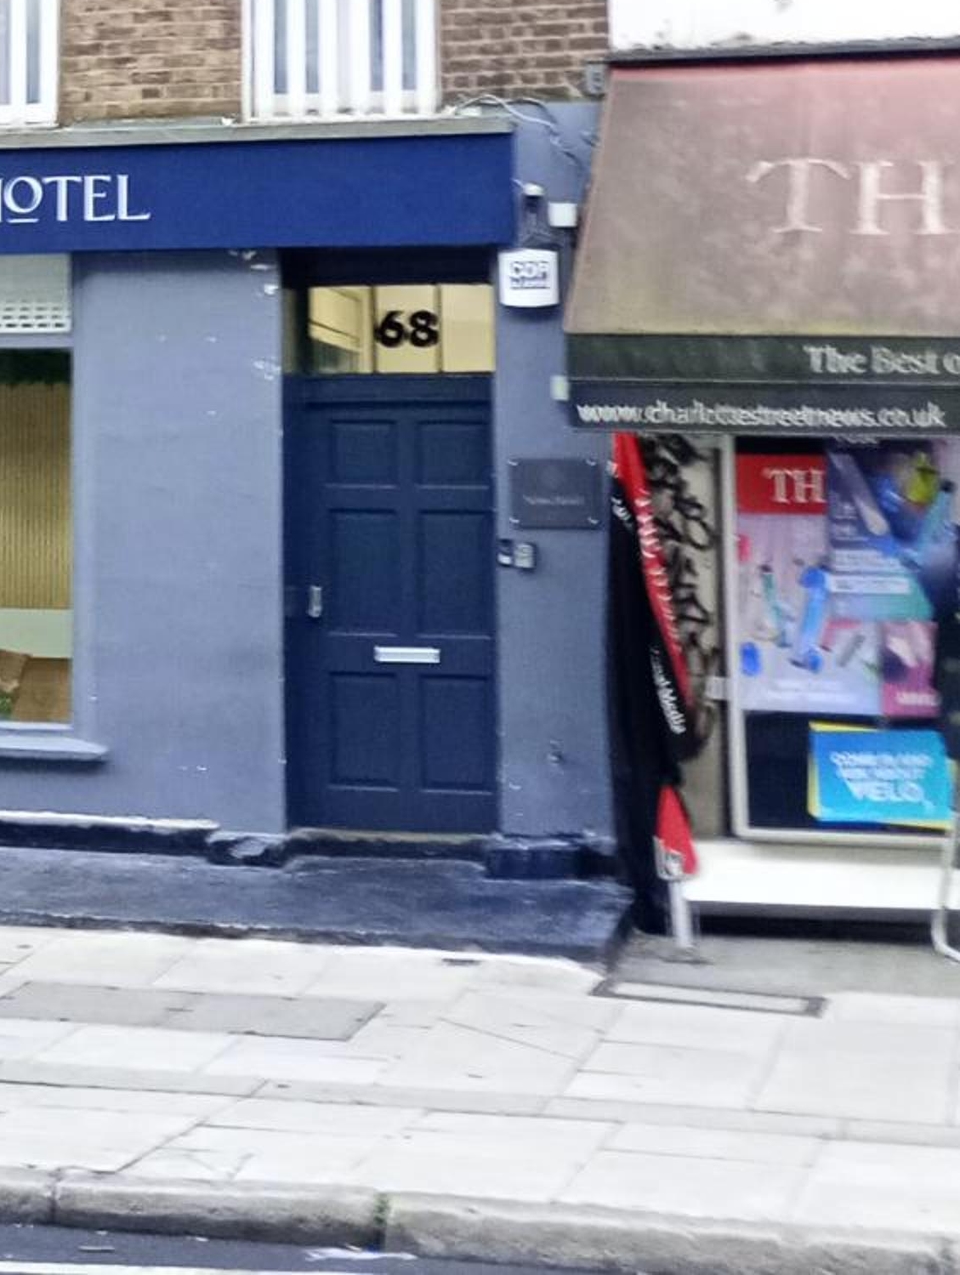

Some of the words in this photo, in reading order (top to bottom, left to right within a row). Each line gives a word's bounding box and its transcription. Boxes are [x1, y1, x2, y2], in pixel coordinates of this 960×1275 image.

[375, 310, 439, 348] 68
[803, 344, 867, 373] The
[870, 345, 941, 375] Best
